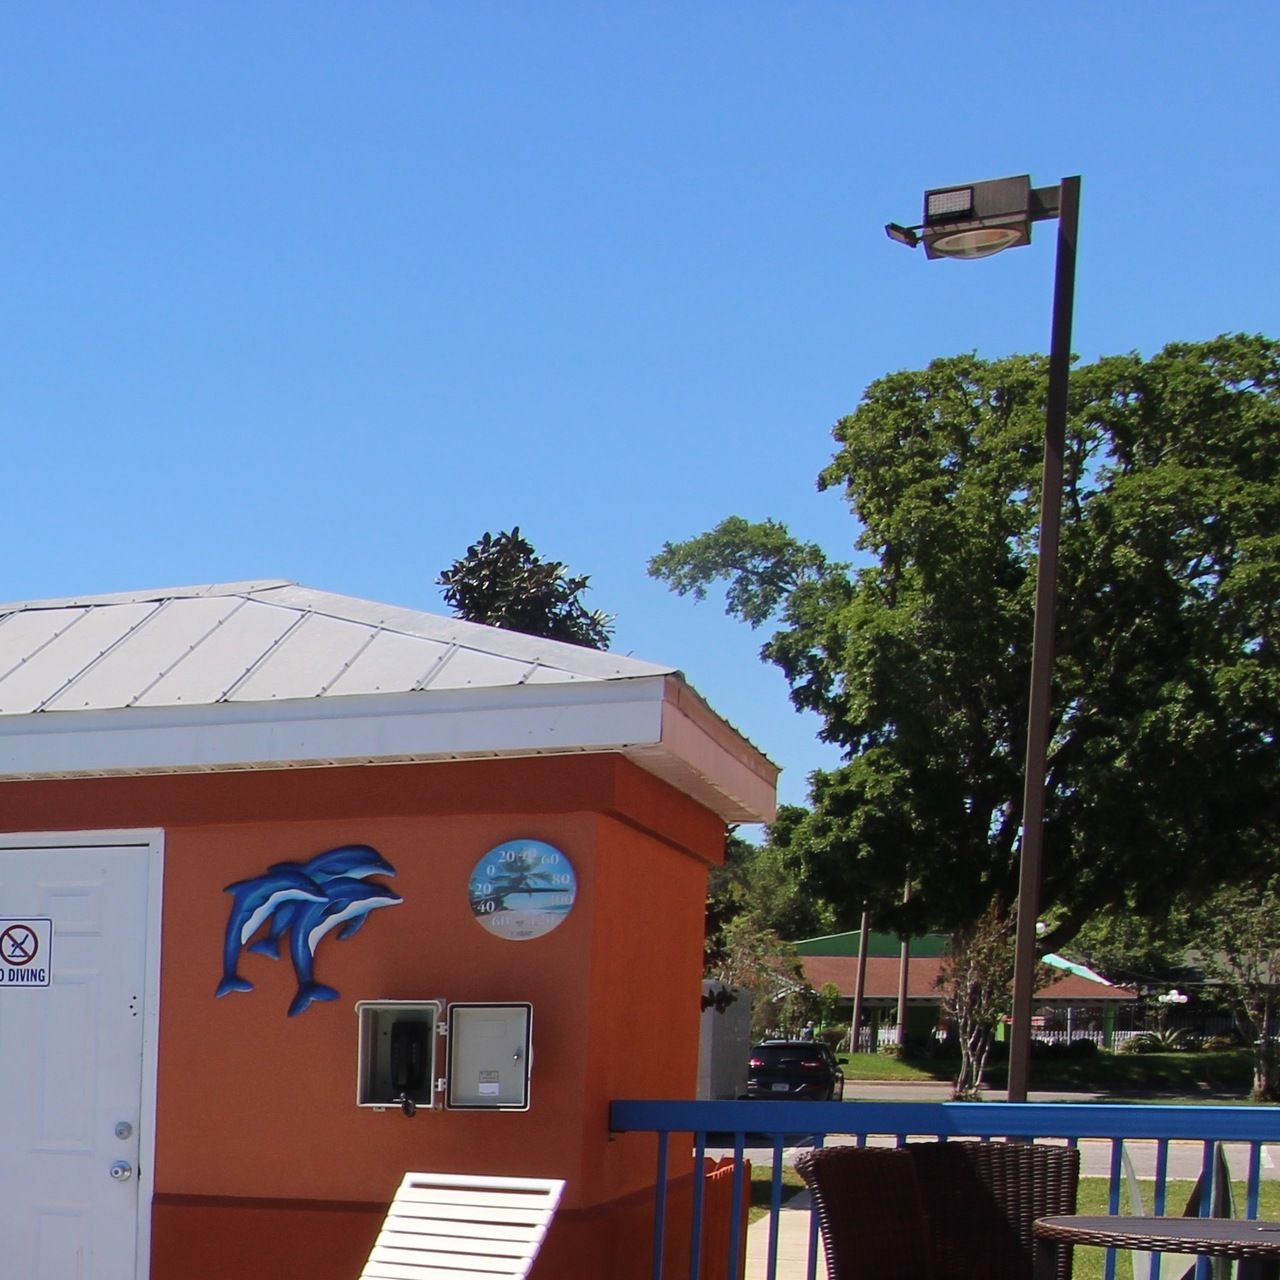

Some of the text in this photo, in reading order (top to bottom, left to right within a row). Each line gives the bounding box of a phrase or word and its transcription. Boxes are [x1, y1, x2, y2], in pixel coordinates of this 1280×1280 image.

[498, 850, 515, 863] 20
[541, 854, 559, 865] 60
[487, 865, 495, 876] 0
[551, 874, 570, 885] 80
[8, 968, 46, 982] DIVING
